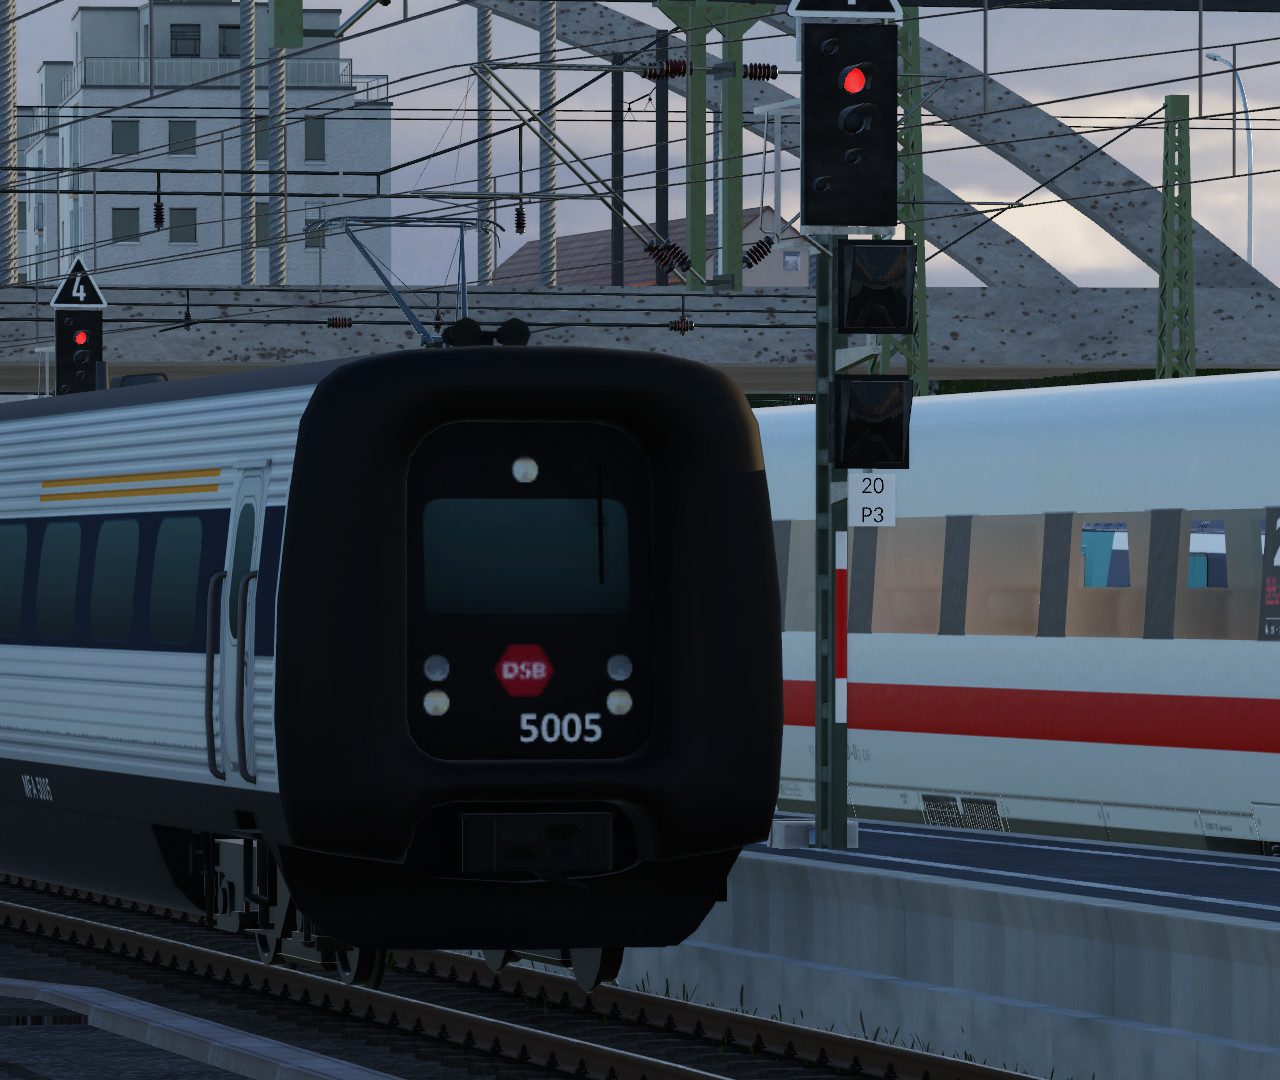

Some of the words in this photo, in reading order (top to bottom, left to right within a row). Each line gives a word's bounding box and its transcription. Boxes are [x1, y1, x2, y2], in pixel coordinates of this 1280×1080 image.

[72, 273, 86, 301] 4
[862, 477, 884, 494] 20
[862, 506, 884, 523] P3
[502, 661, 547, 679] DSB
[520, 712, 602, 743] 5005
